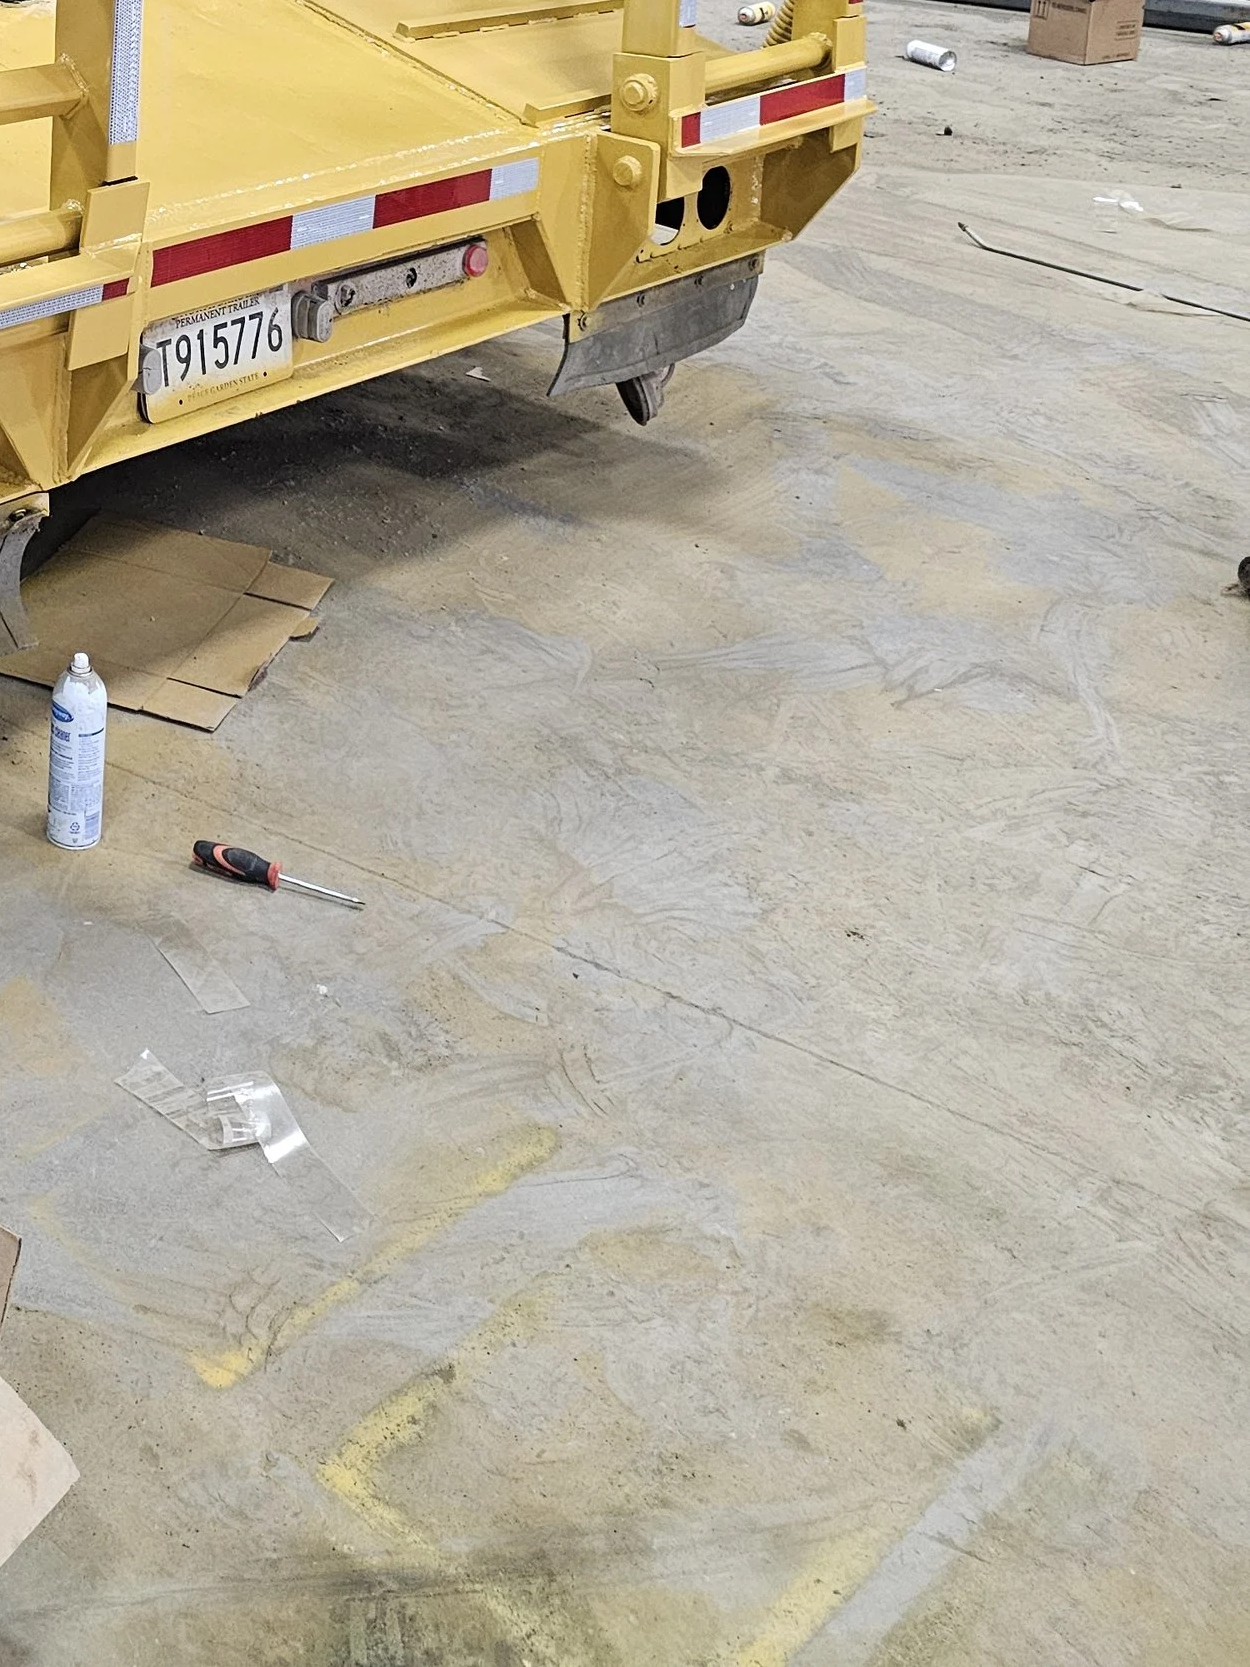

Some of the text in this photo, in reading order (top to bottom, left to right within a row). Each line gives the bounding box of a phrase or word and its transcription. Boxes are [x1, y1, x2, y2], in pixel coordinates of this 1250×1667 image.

[175, 306, 227, 329] PERMANENT
[228, 296, 260, 314] TRAILER
[156, 307, 283, 388] T915776
[239, 372, 259, 385] STATE
